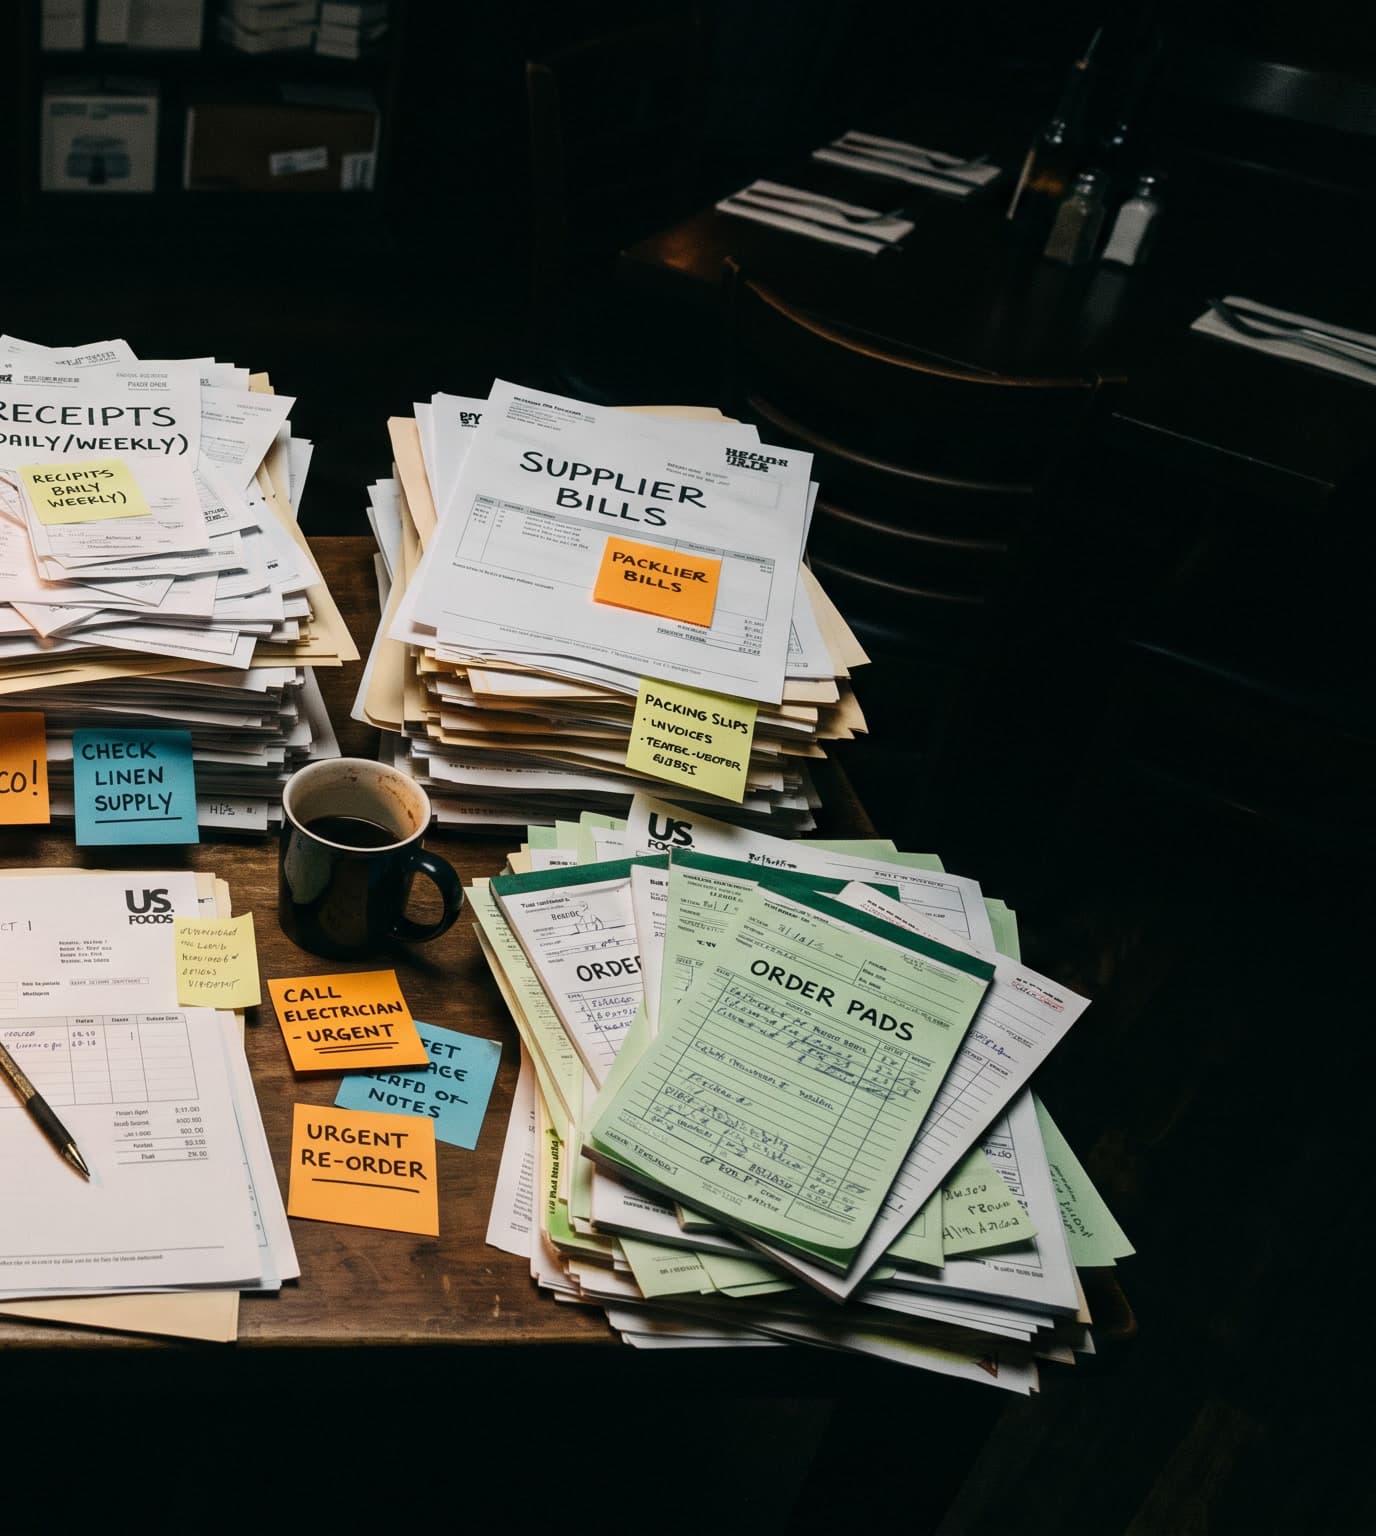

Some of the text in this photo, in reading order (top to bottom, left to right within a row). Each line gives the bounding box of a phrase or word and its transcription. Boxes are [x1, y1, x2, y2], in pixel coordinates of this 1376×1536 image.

[519, 451, 707, 509] SUPPLIER
[556, 486, 667, 527] BILLS
[612, 551, 709, 583] PACKLIER
[623, 570, 683, 593] BILLS
[645, 694, 707, 722] PACKING
[712, 713, 748, 735] SLIPS
[81, 741, 157, 761] CHECK
[95, 766, 164, 787] LINEN
[95, 791, 172, 815] SUPPLY
[28, 920, 33, 932] 1
[129, 913, 174, 925] FOODS
[284, 986, 341, 1002] CALL
[750, 960, 835, 1007] ORDER
[846, 1000, 914, 1041] PADS
[284, 1001, 403, 1022] ELECTRICIAN
[307, 1024, 394, 1043] URGENT
[368, 1087, 441, 1118] NOTES
[307, 1123, 408, 1148] URGENT
[302, 1149, 427, 1180] RE-ORDER
